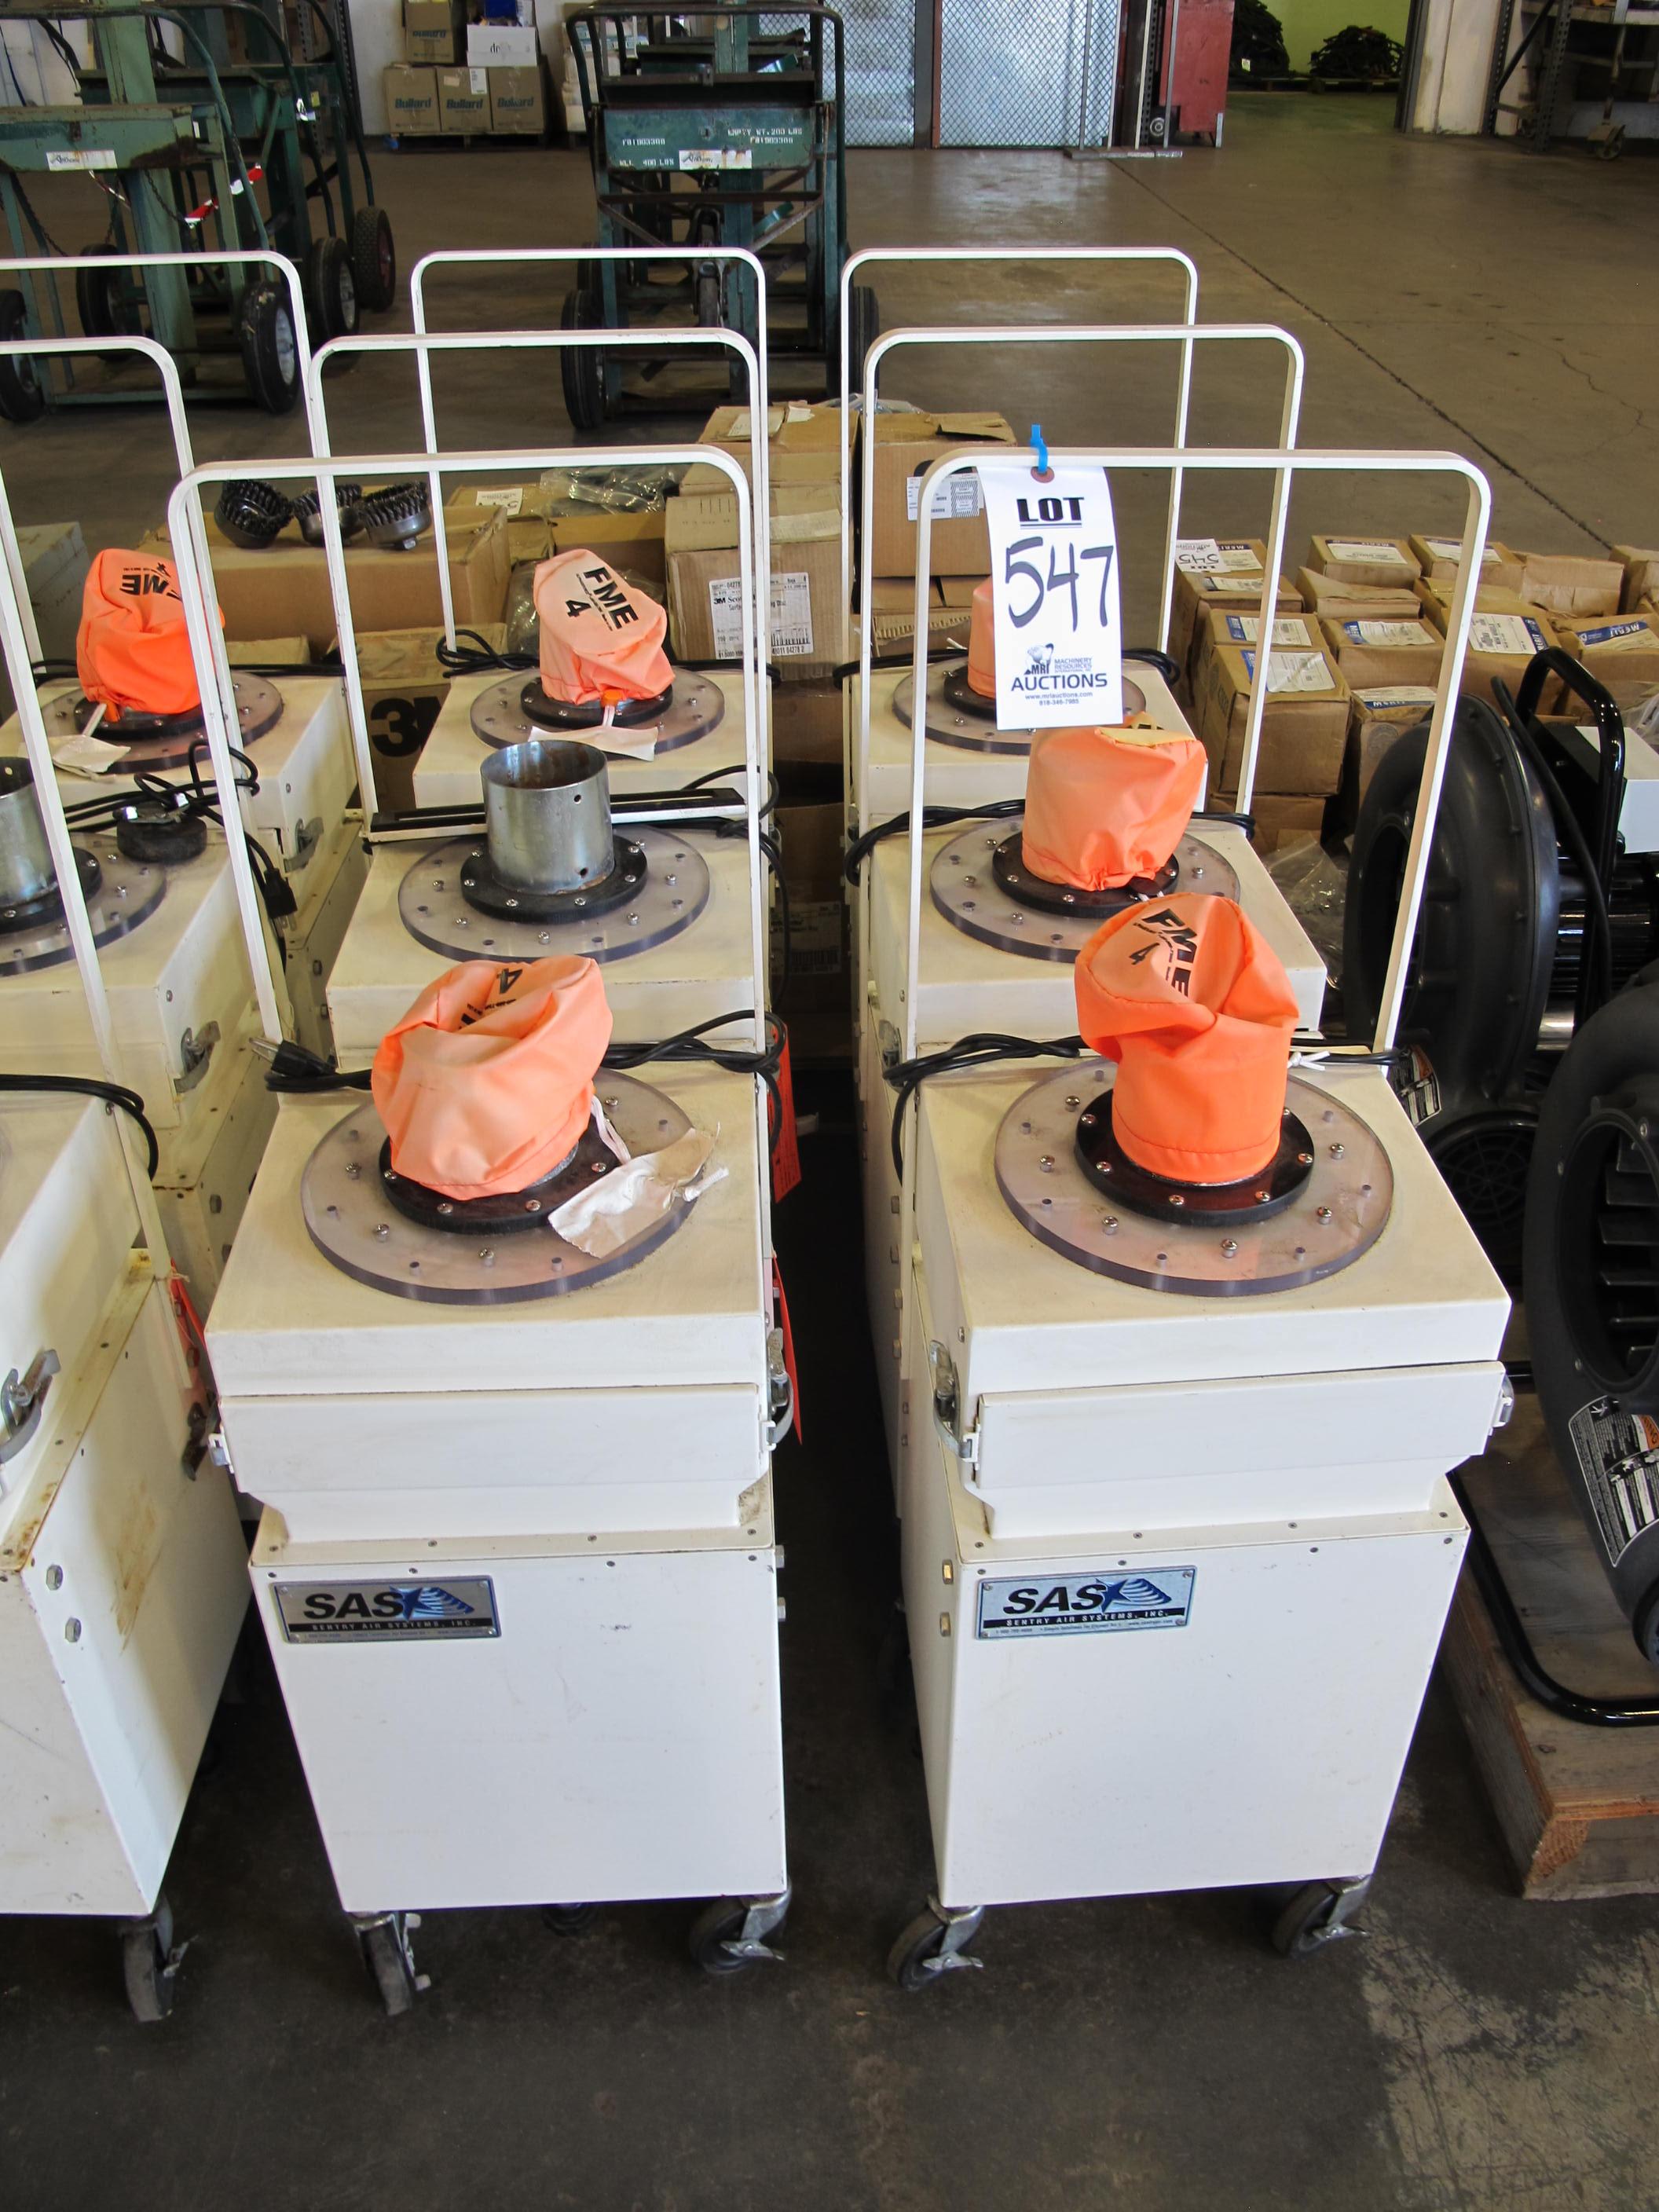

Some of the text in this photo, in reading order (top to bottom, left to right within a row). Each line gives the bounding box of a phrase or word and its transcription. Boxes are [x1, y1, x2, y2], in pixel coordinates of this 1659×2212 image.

[395, 97, 431, 108] Bullard
[446, 99, 483, 109] Bullard
[1016, 496, 1085, 522] LOT
[1178, 554, 1219, 565] 545
[1005, 537, 1114, 632] 547
[583, 566, 639, 629] FME
[565, 599, 591, 618] 4
[1610, 621, 1640, 638] MERIT
[1031, 664, 1049, 675] MRI
[1011, 673, 1108, 691] AUCTIONS
[1129, 943, 1160, 965] 4
[1142, 908, 1198, 997] FME
[496, 968, 523, 994] 4
[303, 1591, 405, 1619] SAS
[1002, 1584, 1106, 1614] SAS
[1006, 1618, 1050, 1627] SENTRY
